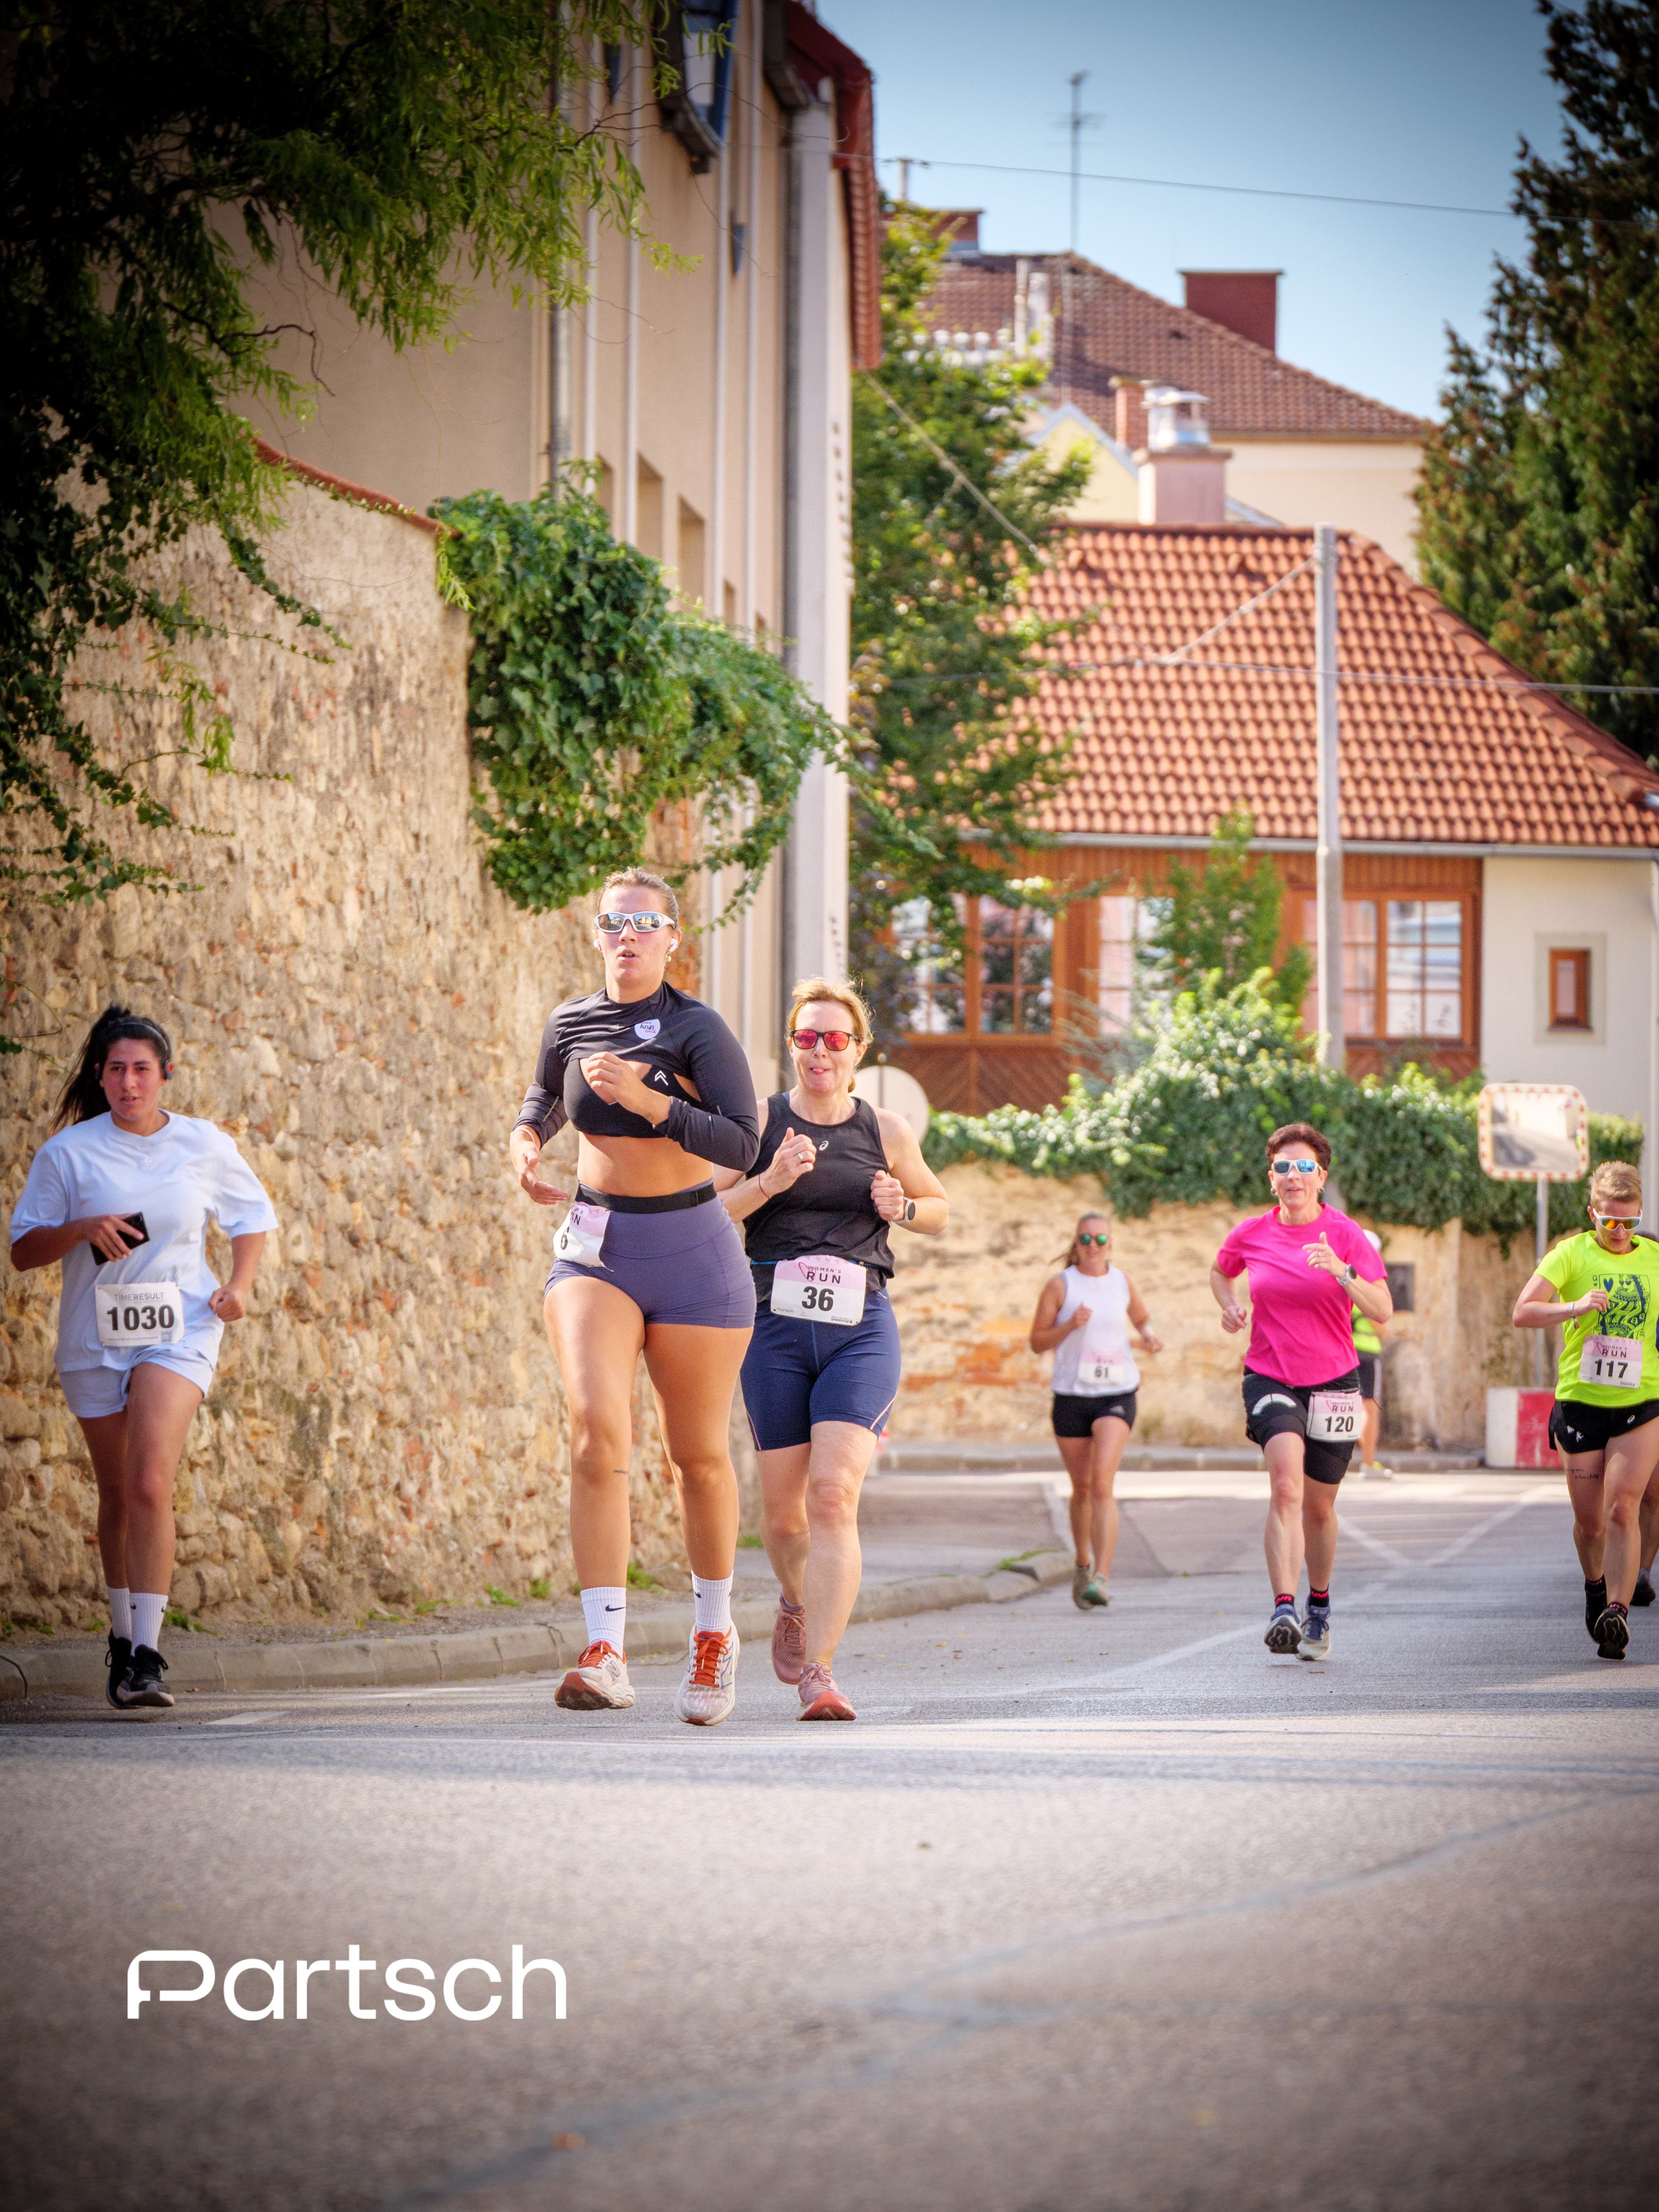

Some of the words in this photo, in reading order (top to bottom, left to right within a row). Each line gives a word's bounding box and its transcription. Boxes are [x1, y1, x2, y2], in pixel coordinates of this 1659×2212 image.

[806, 1271, 841, 1284] RUN
[801, 1286, 834, 1311] 36
[107, 1304, 175, 1330] 1030
[1602, 1349, 1626, 1358] RUN
[1095, 1365, 1109, 1378] 61
[1595, 1358, 1628, 1379] 117
[1324, 1415, 1354, 1432] 120
